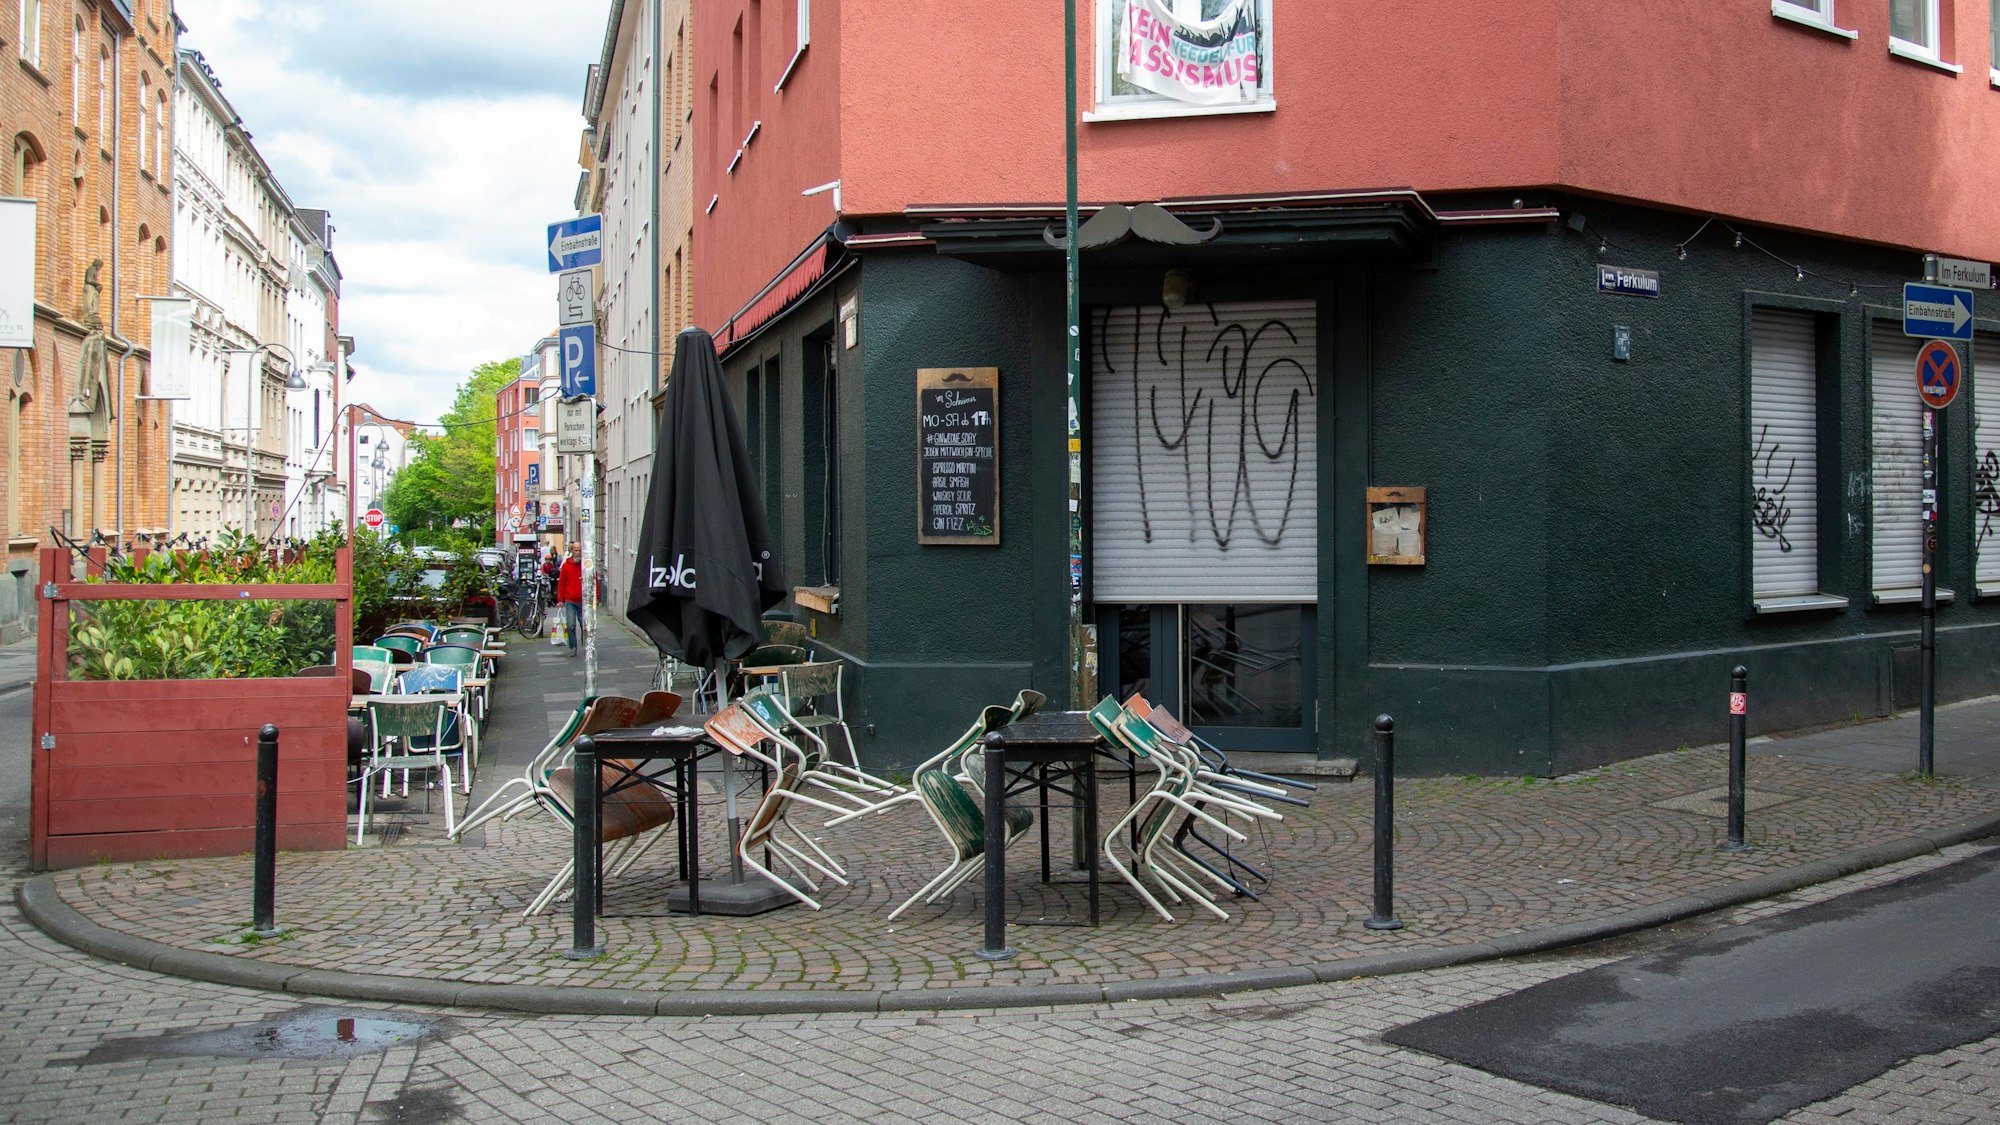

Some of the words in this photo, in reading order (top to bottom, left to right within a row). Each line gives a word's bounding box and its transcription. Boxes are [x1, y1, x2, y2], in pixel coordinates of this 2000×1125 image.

[561, 235, 597, 251] Einbahnstraße
[1617, 270, 1657, 291] Ferkulum
[1942, 264, 1951, 280] Im
[1953, 265, 1986, 284] Ferkulum
[1908, 304, 1955, 319] Einbahnstraße
[565, 336, 583, 389] P
[564, 421, 585, 431] Parkschein
[949, 476, 969, 488] SMASH
[956, 490, 972, 502] SOUR
[955, 503, 976, 516] SPRITZ
[366, 514, 382, 522] STOP
[933, 517, 945, 530] GIN
[946, 517, 964, 531] FIZZ
